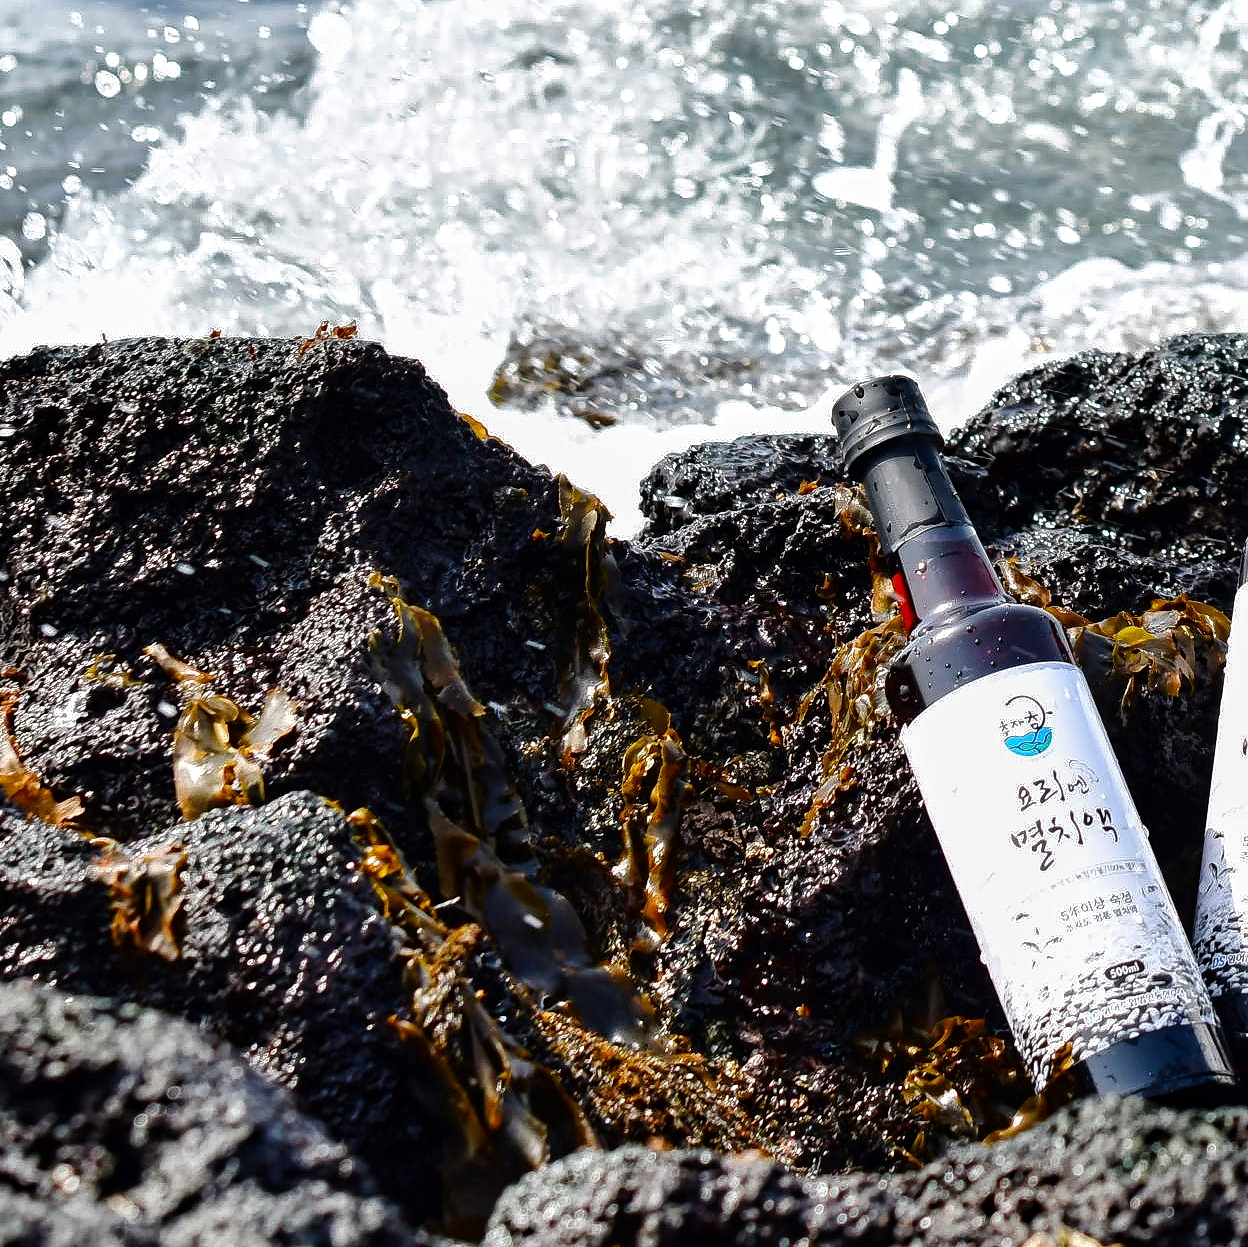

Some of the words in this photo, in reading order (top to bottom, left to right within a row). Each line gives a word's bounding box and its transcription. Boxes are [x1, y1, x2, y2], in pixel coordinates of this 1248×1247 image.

[1018, 769, 1090, 813] 요리엔
[1010, 808, 1118, 871] 멸치액
[1109, 890, 1133, 906] 숙성
[1109, 960, 1140, 980] 500ml
